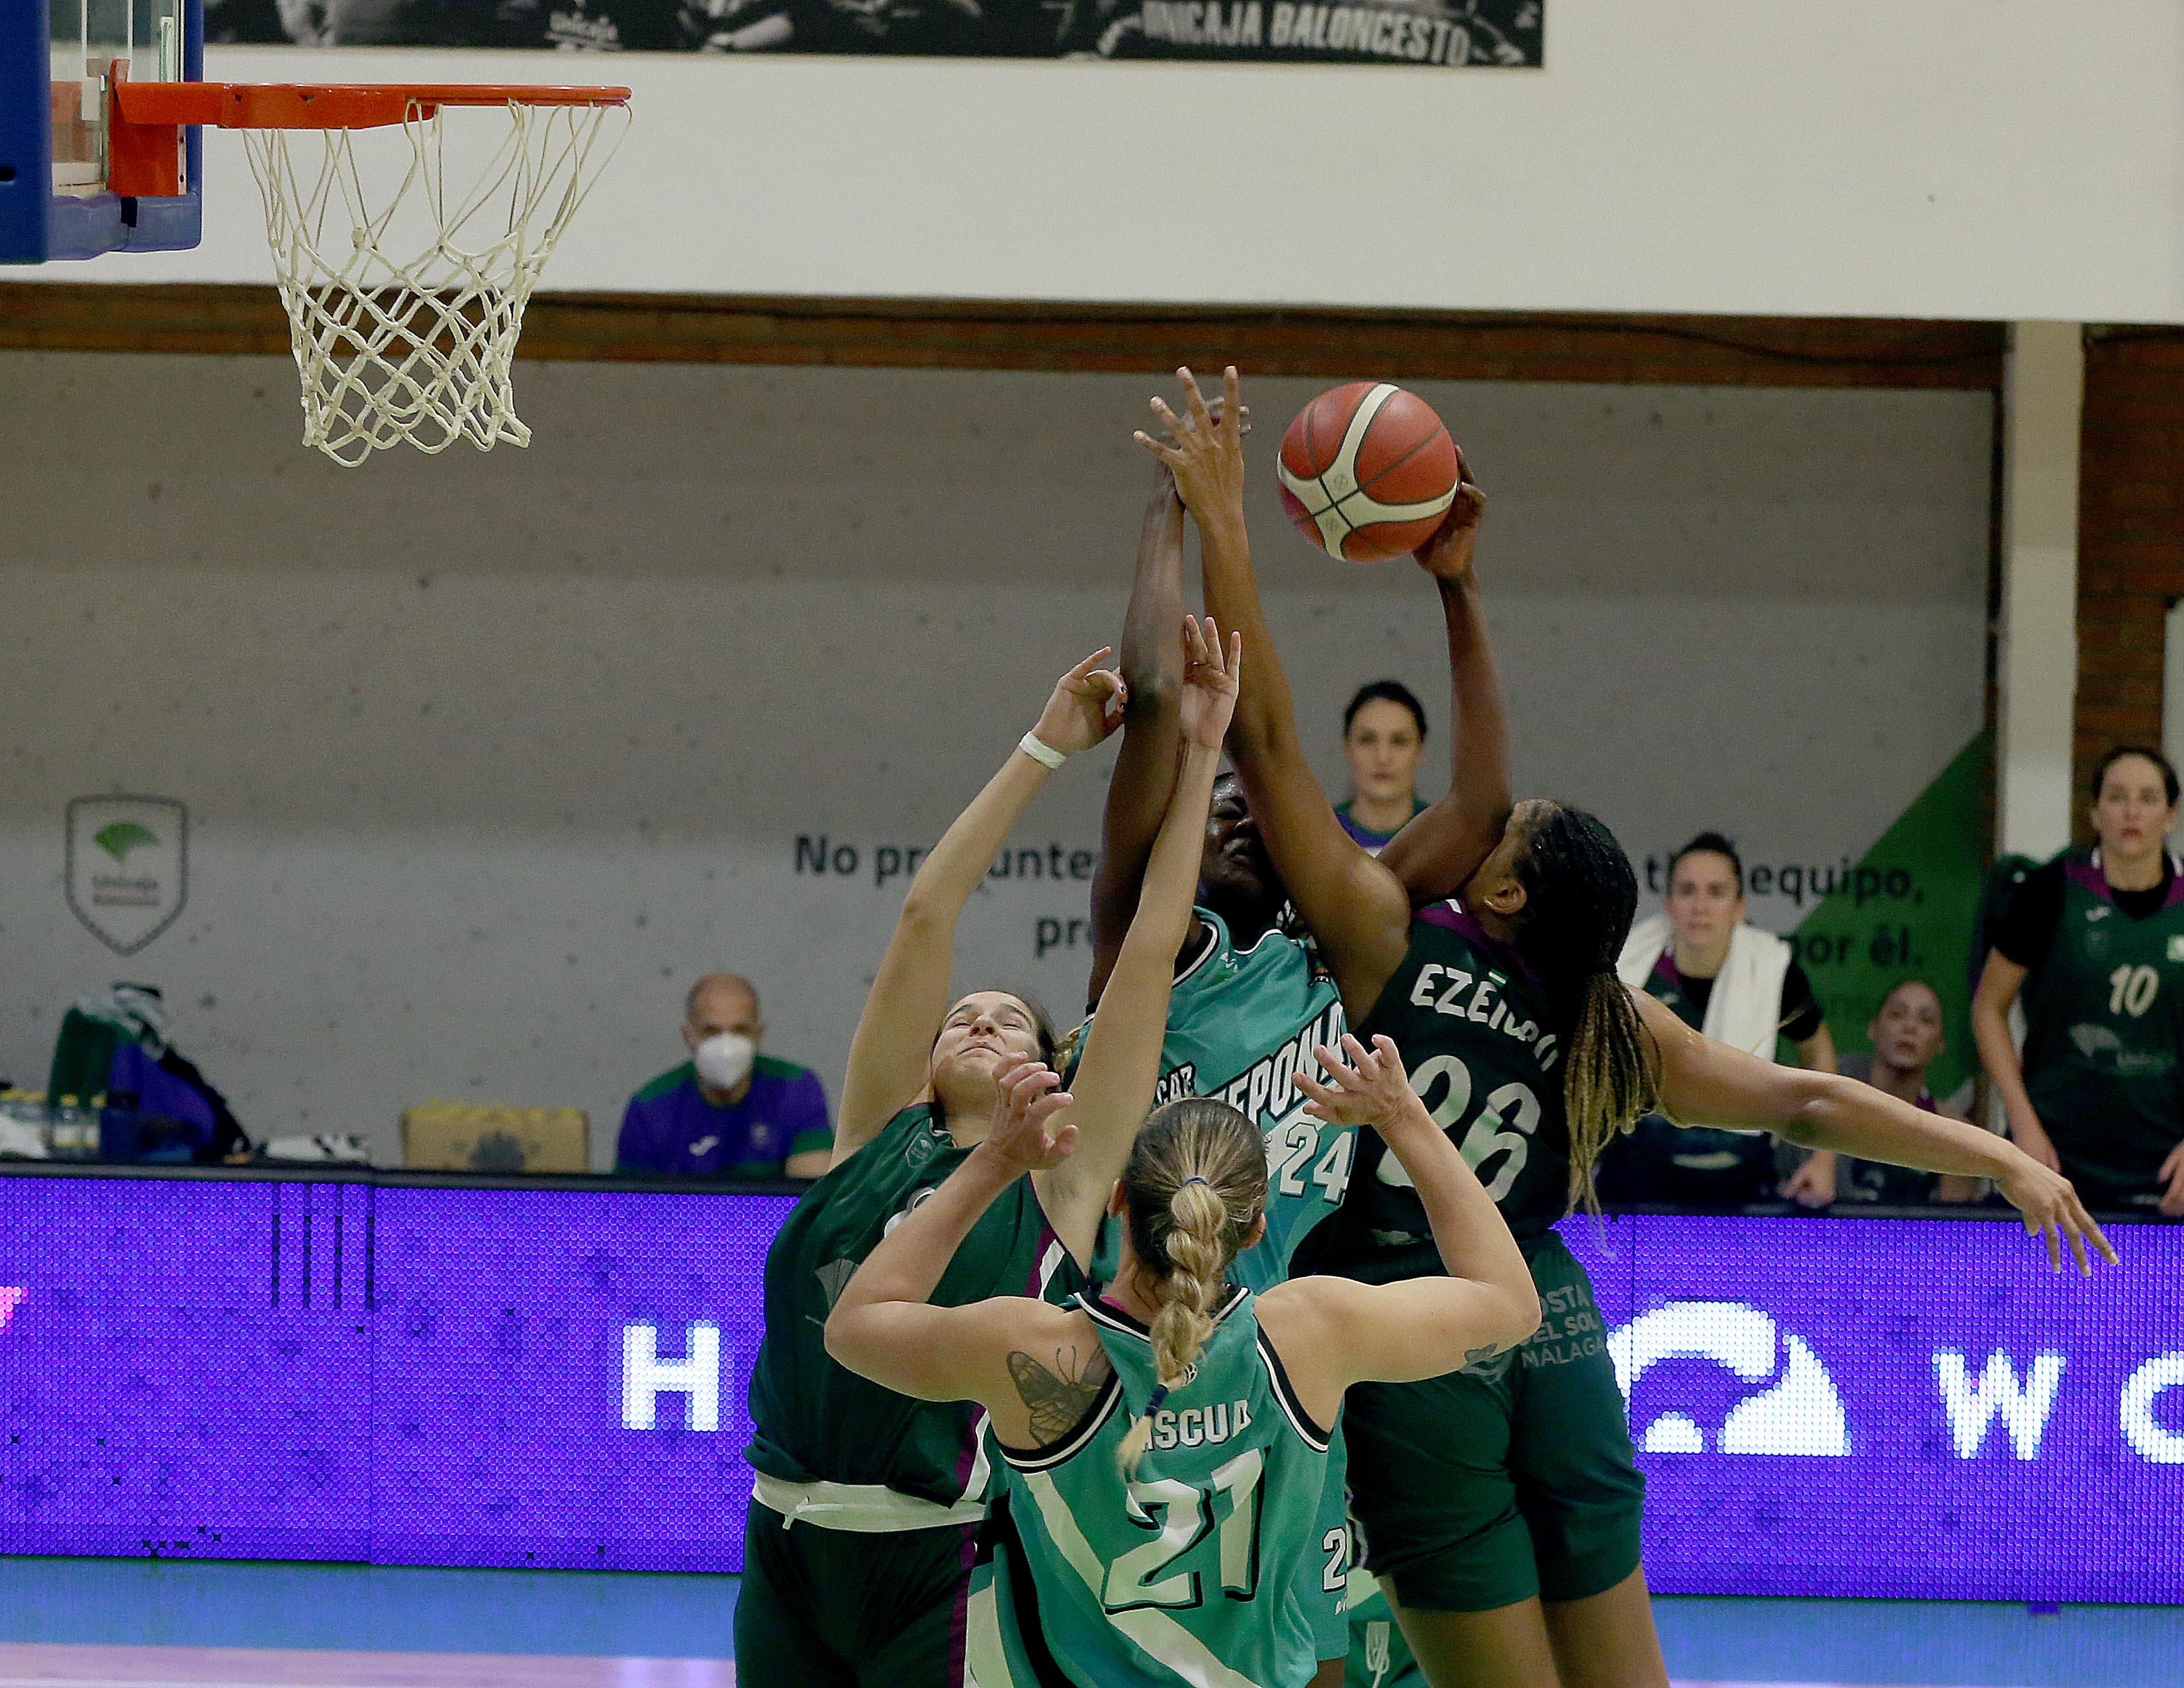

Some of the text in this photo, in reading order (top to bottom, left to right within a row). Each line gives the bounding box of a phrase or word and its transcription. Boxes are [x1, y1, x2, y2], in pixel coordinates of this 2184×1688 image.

[1269, 3, 1471, 66] BALONCESTO
[796, 835, 859, 875] No
[1751, 857, 1924, 909] equipo,
[2109, 964, 2160, 1017] 10
[1376, 1055, 1541, 1202] 26
[1279, 1123, 1354, 1203] 24
[1520, 1312, 1600, 1346] EL SOL
[1129, 1399, 1253, 1451] SCUA
[1103, 1447, 1264, 1614] 21
